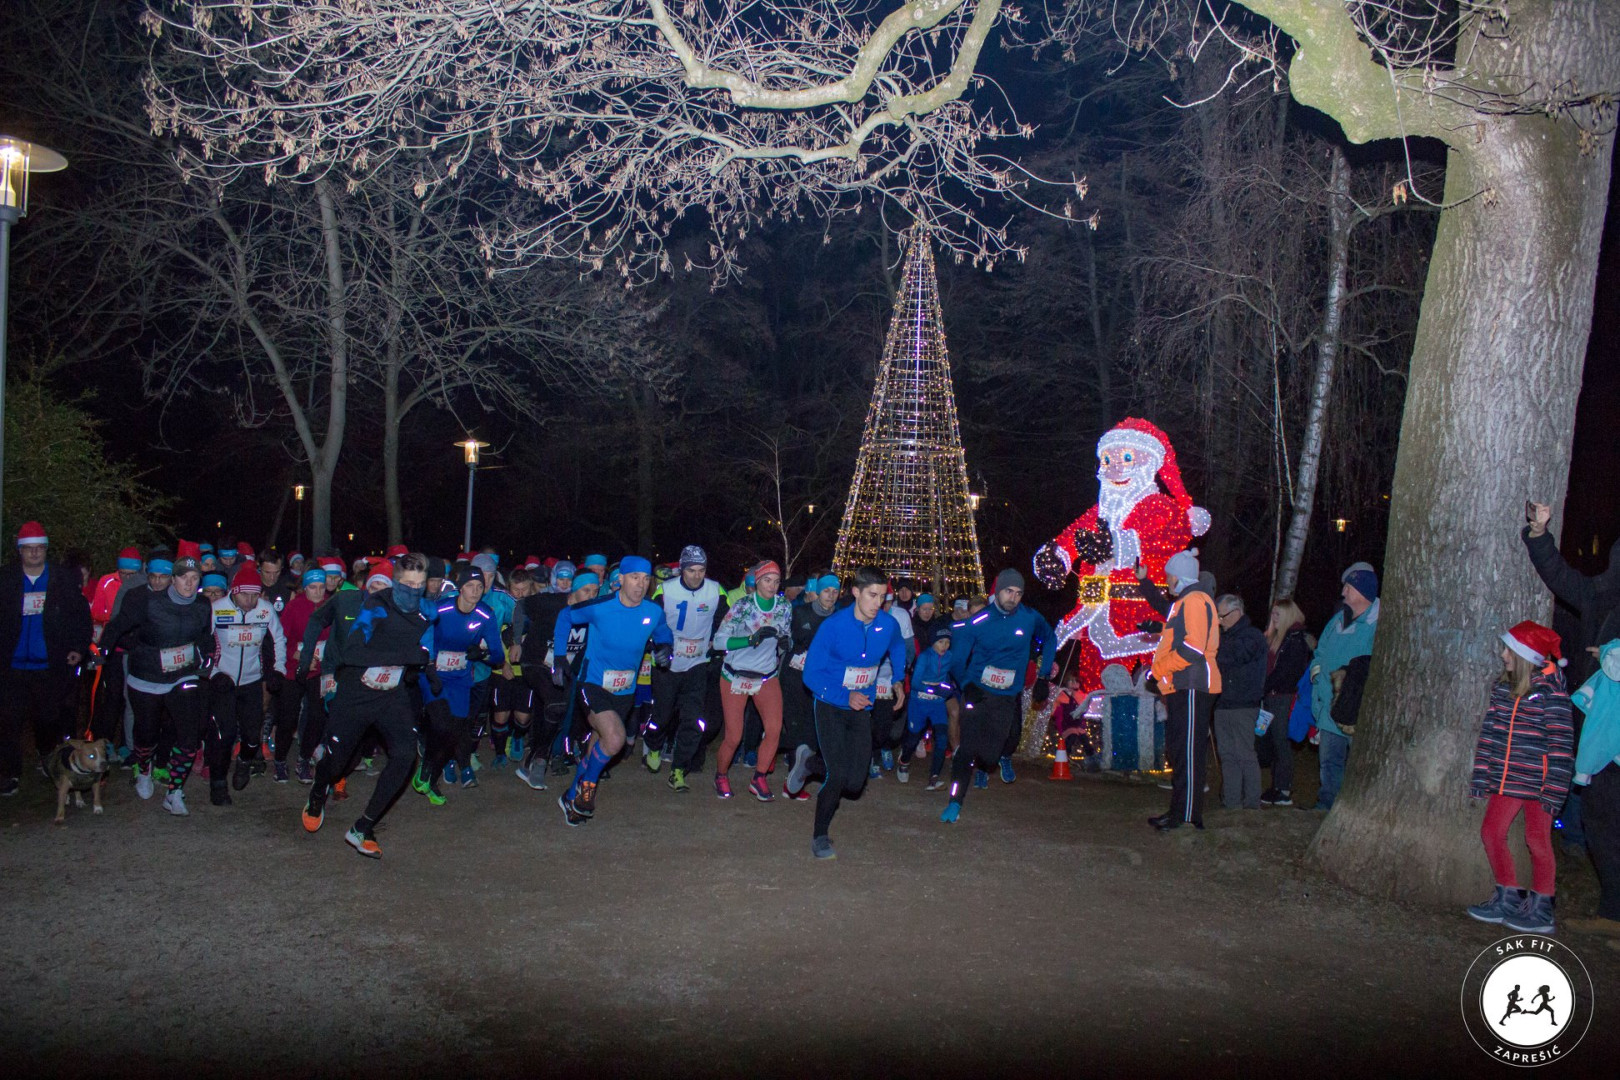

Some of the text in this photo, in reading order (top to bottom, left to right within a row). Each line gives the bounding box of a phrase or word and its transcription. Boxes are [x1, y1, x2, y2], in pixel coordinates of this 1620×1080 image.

[676, 600, 688, 632] 1
[238, 632, 252, 642] 160
[686, 645, 697, 654] 157
[173, 654, 186, 665] 161
[446, 658, 460, 666] 124
[375, 673, 391, 683] 186
[612, 678, 626, 687] 158
[855, 674, 869, 684] 101
[991, 674, 1006, 684] 065
[740, 682, 752, 690] 156
